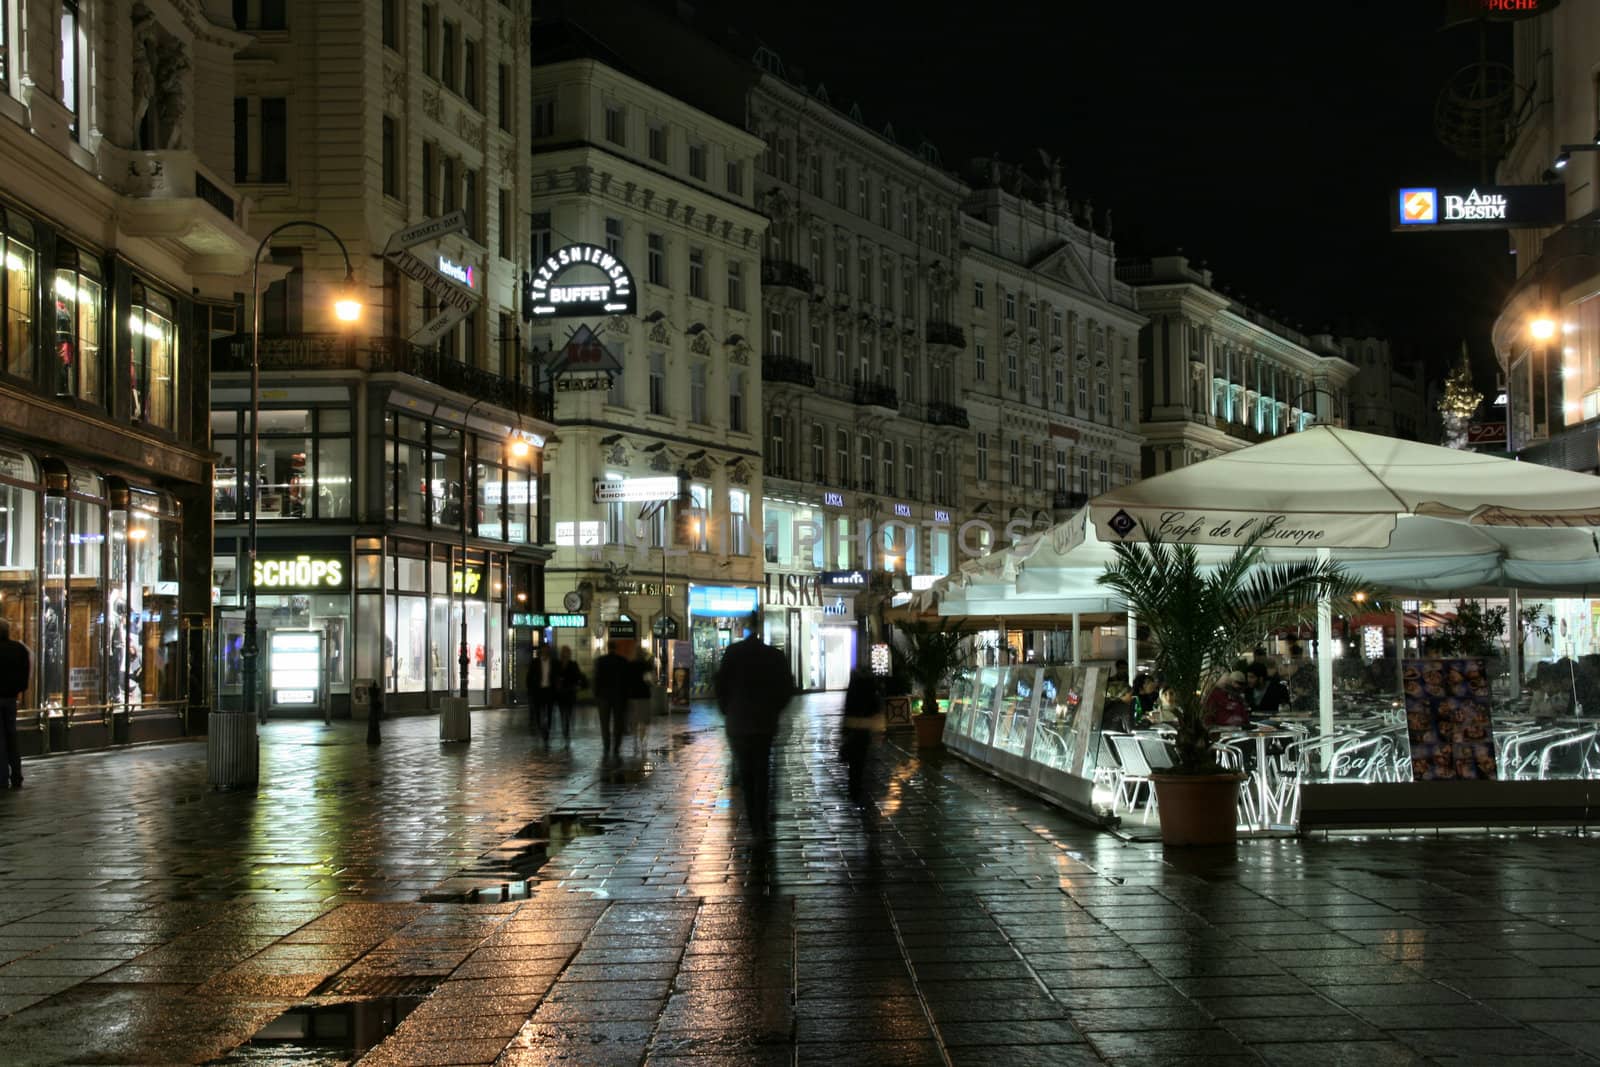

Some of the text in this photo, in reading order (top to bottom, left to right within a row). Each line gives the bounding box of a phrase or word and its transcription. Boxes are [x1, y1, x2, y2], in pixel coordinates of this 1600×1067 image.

[1444, 195, 1507, 220] BESIM
[1464, 188, 1507, 205] ADIL
[531, 246, 630, 301] TRZEŚNIEWSKI
[549, 286, 611, 303] BUFFET
[1158, 511, 1205, 541] Café
[1260, 515, 1326, 545] Europe
[765, 573, 824, 606] LISKA
